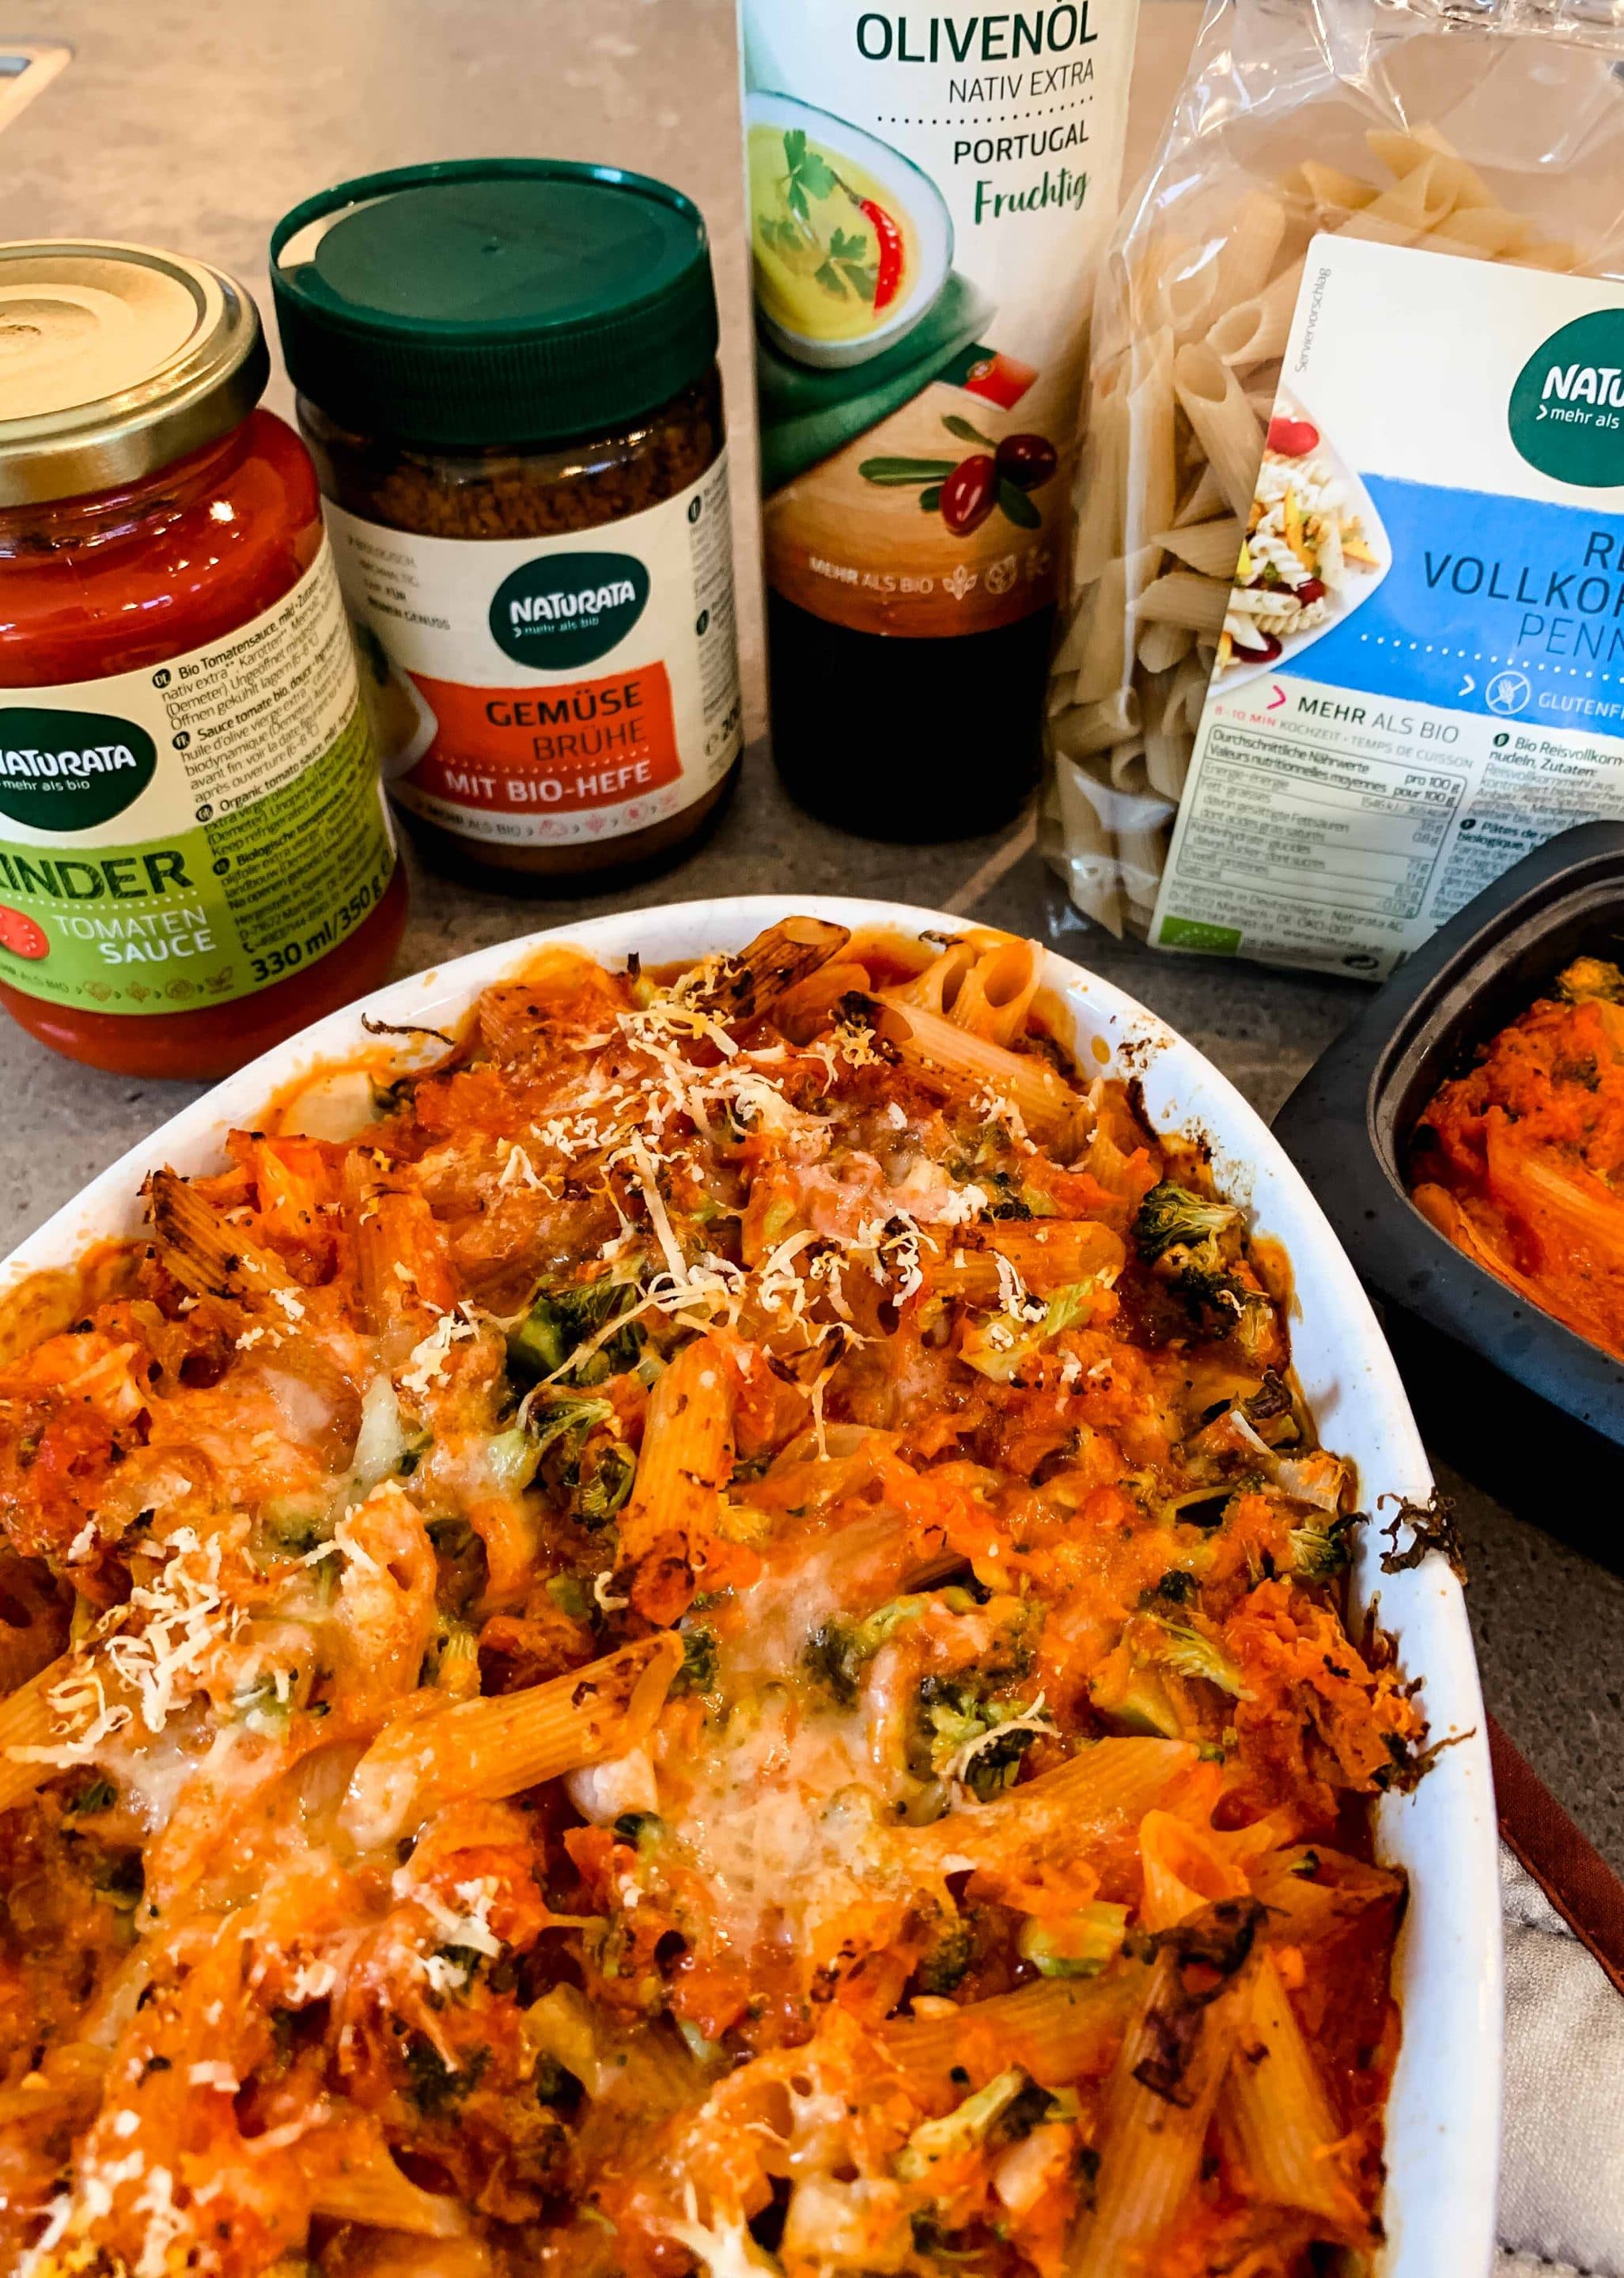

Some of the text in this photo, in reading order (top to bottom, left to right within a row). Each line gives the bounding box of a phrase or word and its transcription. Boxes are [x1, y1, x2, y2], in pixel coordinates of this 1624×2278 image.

[857, 0, 1098, 62] OLIVENÖL
[950, 58, 1095, 104] NATIV EXTRA
[954, 121, 1089, 165] PORTUGAL
[975, 168, 1090, 225] Fruchtig
[1294, 267, 1332, 373] Serviervorschlag
[1550, 406, 1620, 429] mehr als
[509, 581, 636, 625] NATURATA
[861, 572, 896, 592] ALS
[161, 683, 194, 702] nativ
[178, 664, 200, 681] Bio
[197, 719, 236, 742] Sauce
[235, 698, 272, 726] tomate
[486, 682, 642, 727] GEMÜSE
[1297, 696, 1460, 744] MEHR ALS BIO
[533, 717, 645, 762] BRÜHE
[1249, 713, 1277, 728] MIN
[1279, 720, 1342, 743] KOCHZEIT
[1515, 736, 1537, 752] Bio
[180, 743, 212, 763] huile
[42, 780, 64, 792] als
[66, 779, 90, 790] bio
[191, 769, 226, 790] avant
[195, 783, 231, 804] après
[220, 786, 263, 812] Organic
[264, 762, 300, 791] tomato
[445, 759, 652, 803] MIT BIO-HEFE
[0, 850, 195, 900] INDER
[51, 904, 208, 941] TOMATEN
[98, 929, 217, 965] SAUCE
[251, 942, 302, 982] 330
